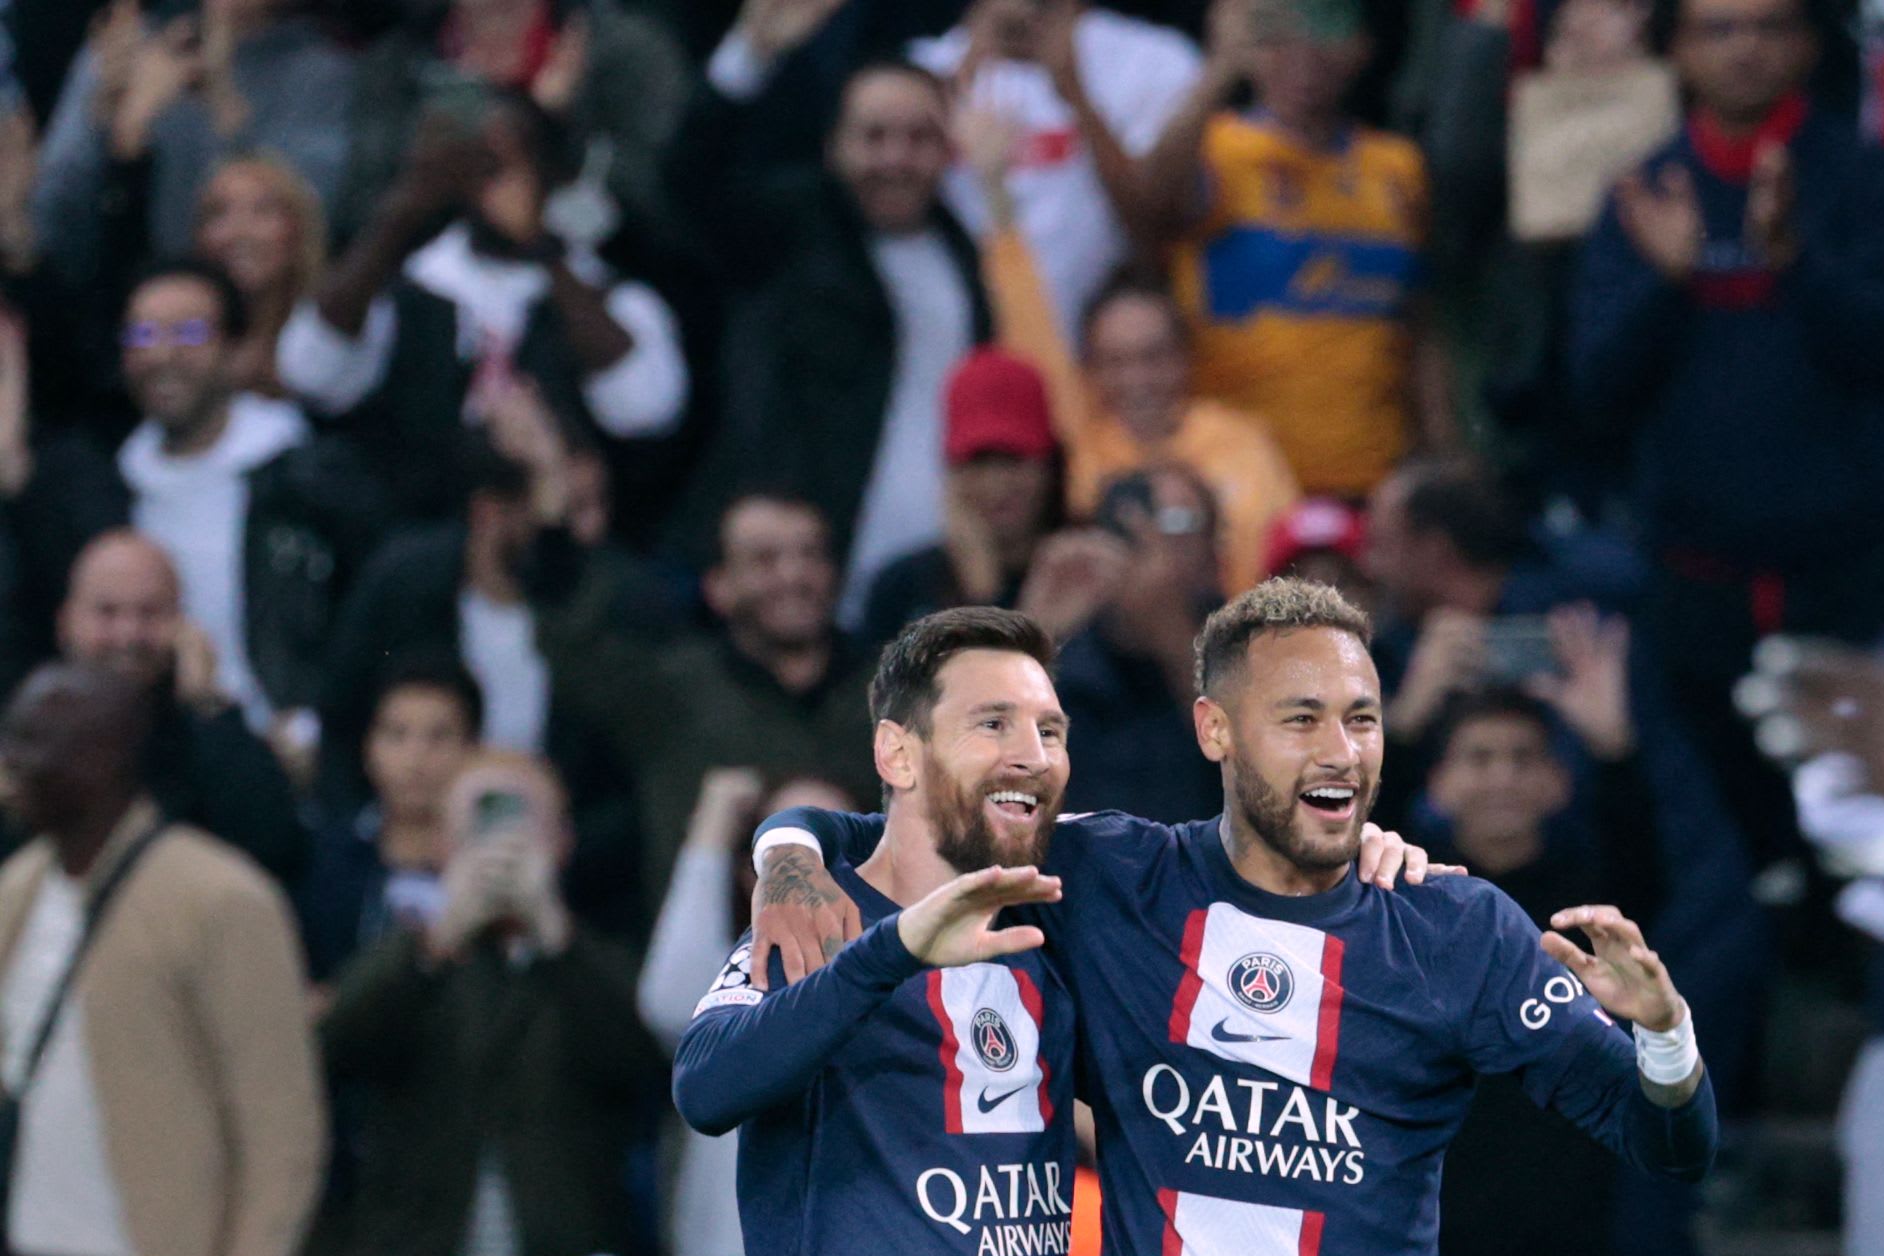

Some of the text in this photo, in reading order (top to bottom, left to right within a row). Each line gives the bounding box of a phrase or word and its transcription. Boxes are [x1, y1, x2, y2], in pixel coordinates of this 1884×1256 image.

[1241, 956, 1284, 976] PARIS
[1142, 1063, 1363, 1149] QATAR
[1184, 1131, 1365, 1186] AIRWAYS
[916, 1160, 1072, 1236] QATAR
